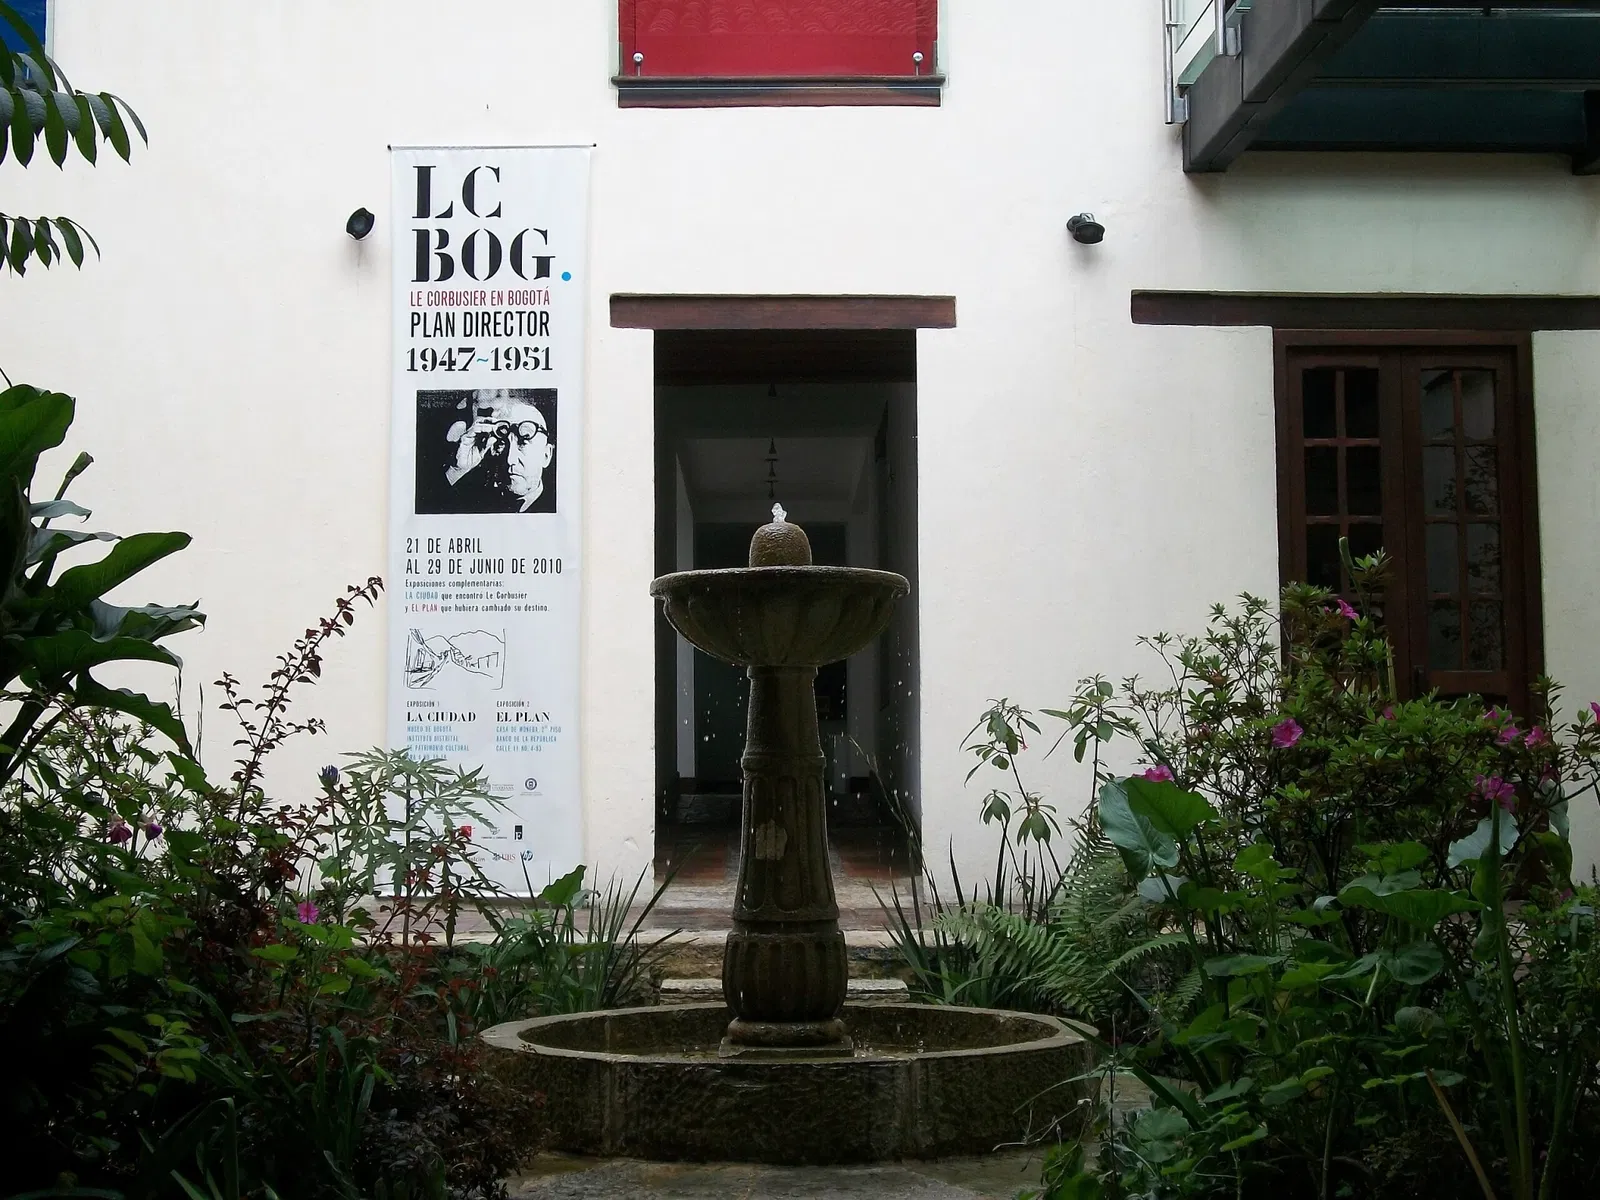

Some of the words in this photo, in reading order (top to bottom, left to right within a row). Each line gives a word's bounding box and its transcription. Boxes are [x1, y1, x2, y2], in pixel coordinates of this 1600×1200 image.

[412, 165, 502, 219] LC
[410, 291, 423, 307] LE
[427, 290, 487, 306] CORBUSIER
[491, 290, 504, 306] EN
[508, 286, 550, 306] BOGOTÁ
[411, 312, 455, 338] PLAN
[463, 311, 550, 337] DIRECTOR
[406, 537, 419, 554] 21
[428, 537, 441, 554] DE
[448, 537, 483, 554] ABRIL
[406, 558, 420, 575] AL
[427, 558, 441, 575] 29
[448, 558, 462, 575] DE
[470, 558, 504, 575] JUNIO
[512, 558, 526, 575] DE
[533, 558, 562, 574] 2010
[405, 579, 446, 589] Exposiciones
[448, 579, 504, 589] complementarias:
[405, 592, 413, 600] LA
[416, 592, 439, 600] CIUDAD
[441, 593, 452, 601] que
[455, 591, 483, 600] encontró
[486, 591, 493, 600] Le
[496, 591, 528, 600] Corbusier
[404, 605, 409, 614] y
[411, 604, 419, 612] EL
[422, 604, 438, 612] PLAN
[440, 605, 452, 614] que
[454, 604, 479, 612] hubiera
[481, 604, 512, 612] cambiado
[523, 604, 550, 612] destino.
[406, 700, 435, 708] EXPOSICIÓN
[496, 699, 525, 708] EXPOSICIÓN
[407, 711, 423, 722] LA
[427, 711, 476, 722] CIUDAD
[496, 711, 512, 722] EL
[515, 711, 551, 722] PLAN
[445, 744, 470, 752] CULTURAL
